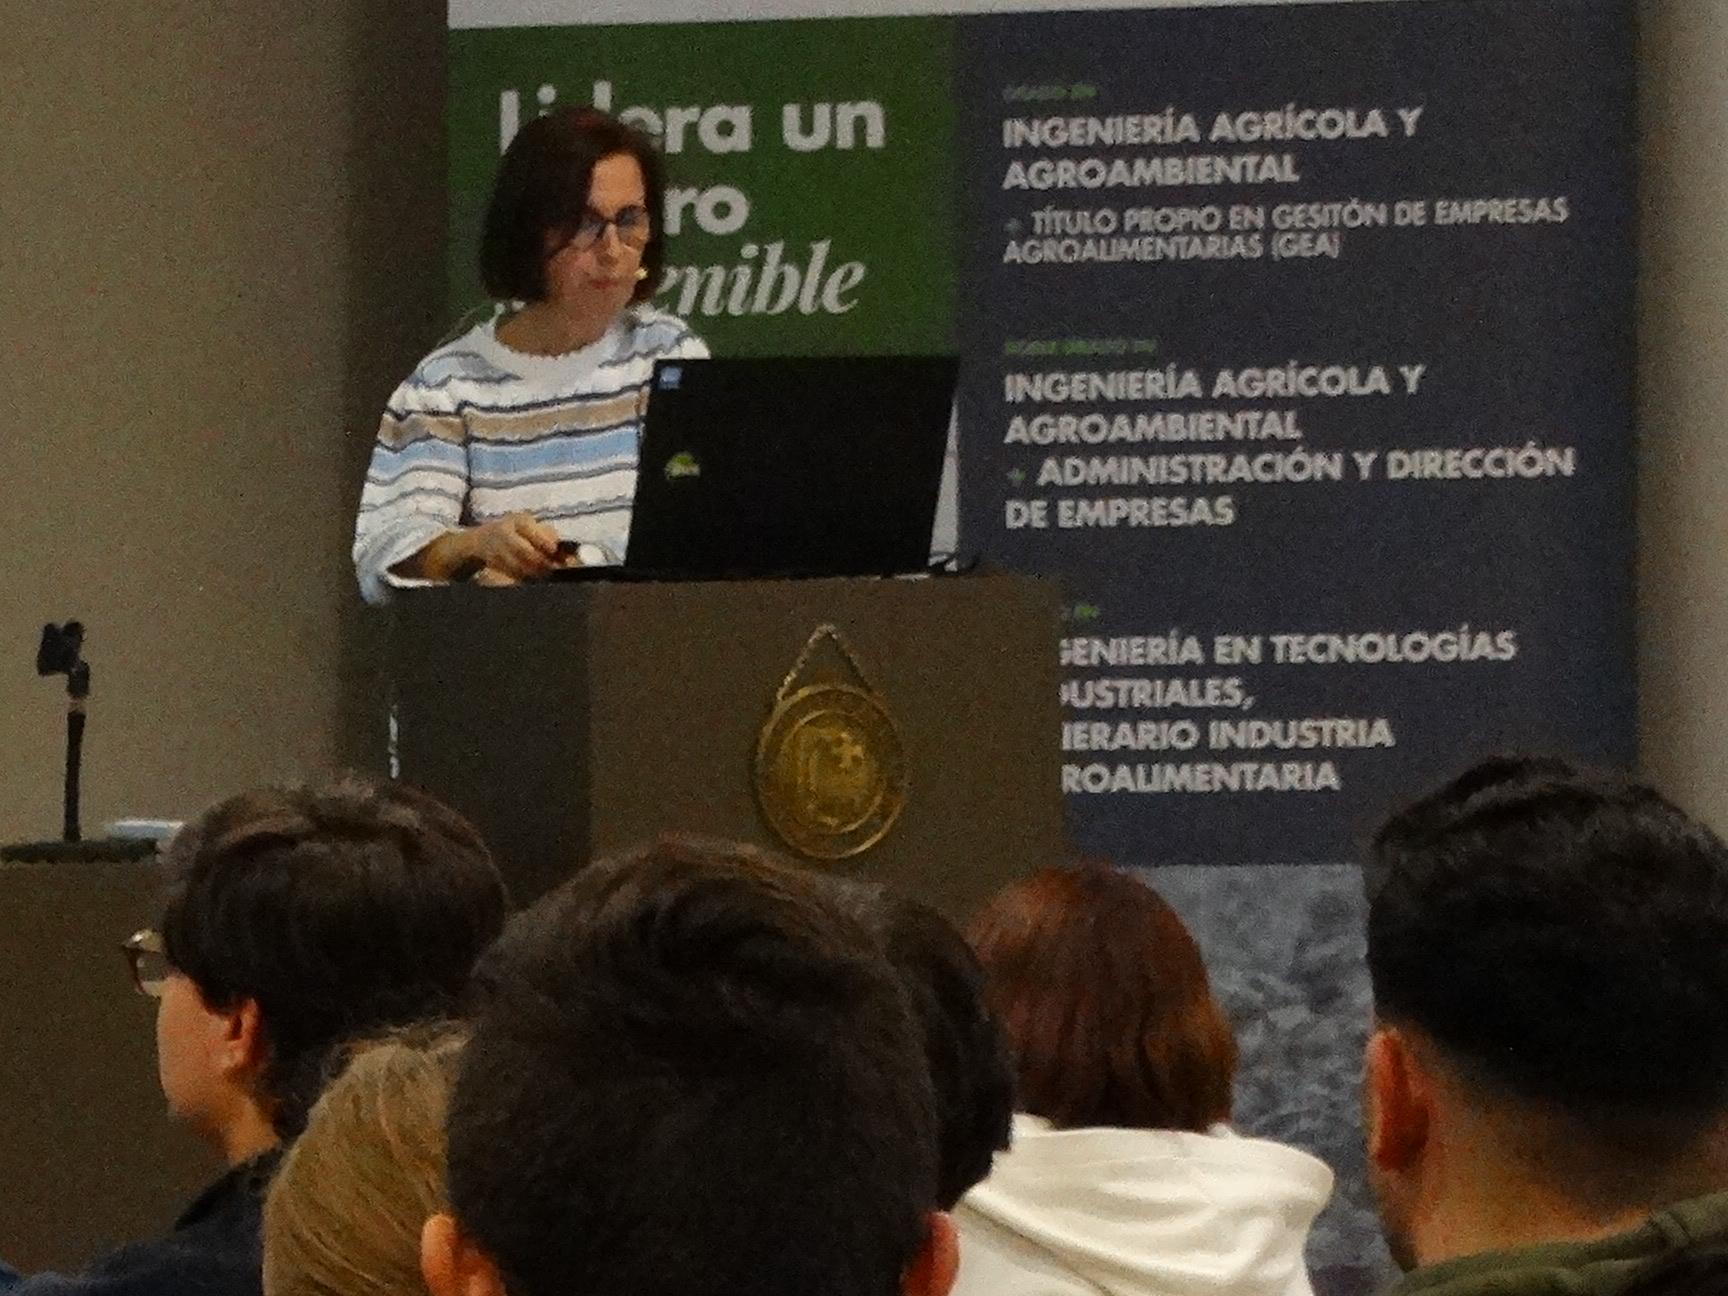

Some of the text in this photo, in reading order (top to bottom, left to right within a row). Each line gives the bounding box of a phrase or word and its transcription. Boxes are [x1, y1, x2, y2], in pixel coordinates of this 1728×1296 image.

[782, 100, 885, 151] un
[1003, 102, 1423, 148] INGENIERÍA AGRÍCOLA Y
[1002, 153, 1301, 190] AGROAMBIENTAL
[1031, 205, 1119, 234] TÍTULO
[1123, 205, 1225, 233] PROPIO
[1228, 204, 1266, 231] EN
[1393, 200, 1427, 227] DE
[1434, 196, 1570, 225] EMPRESAS
[1002, 231, 1264, 264] AGROALIMENTARIAS
[1004, 360, 1426, 403] INGENIERÍA AGRÍCOLA Y
[1003, 410, 1304, 445] AGROAMBIENTAL
[1036, 440, 1575, 486] ADMINISTRACIÓN Y DIRECCIÓN
[1005, 495, 1235, 529] DE EMPRESAS
[1213, 635, 1262, 665] EN
[1269, 623, 1518, 664] TECNOLOGÍAS
[1208, 718, 1395, 749] INDUSTRIA
